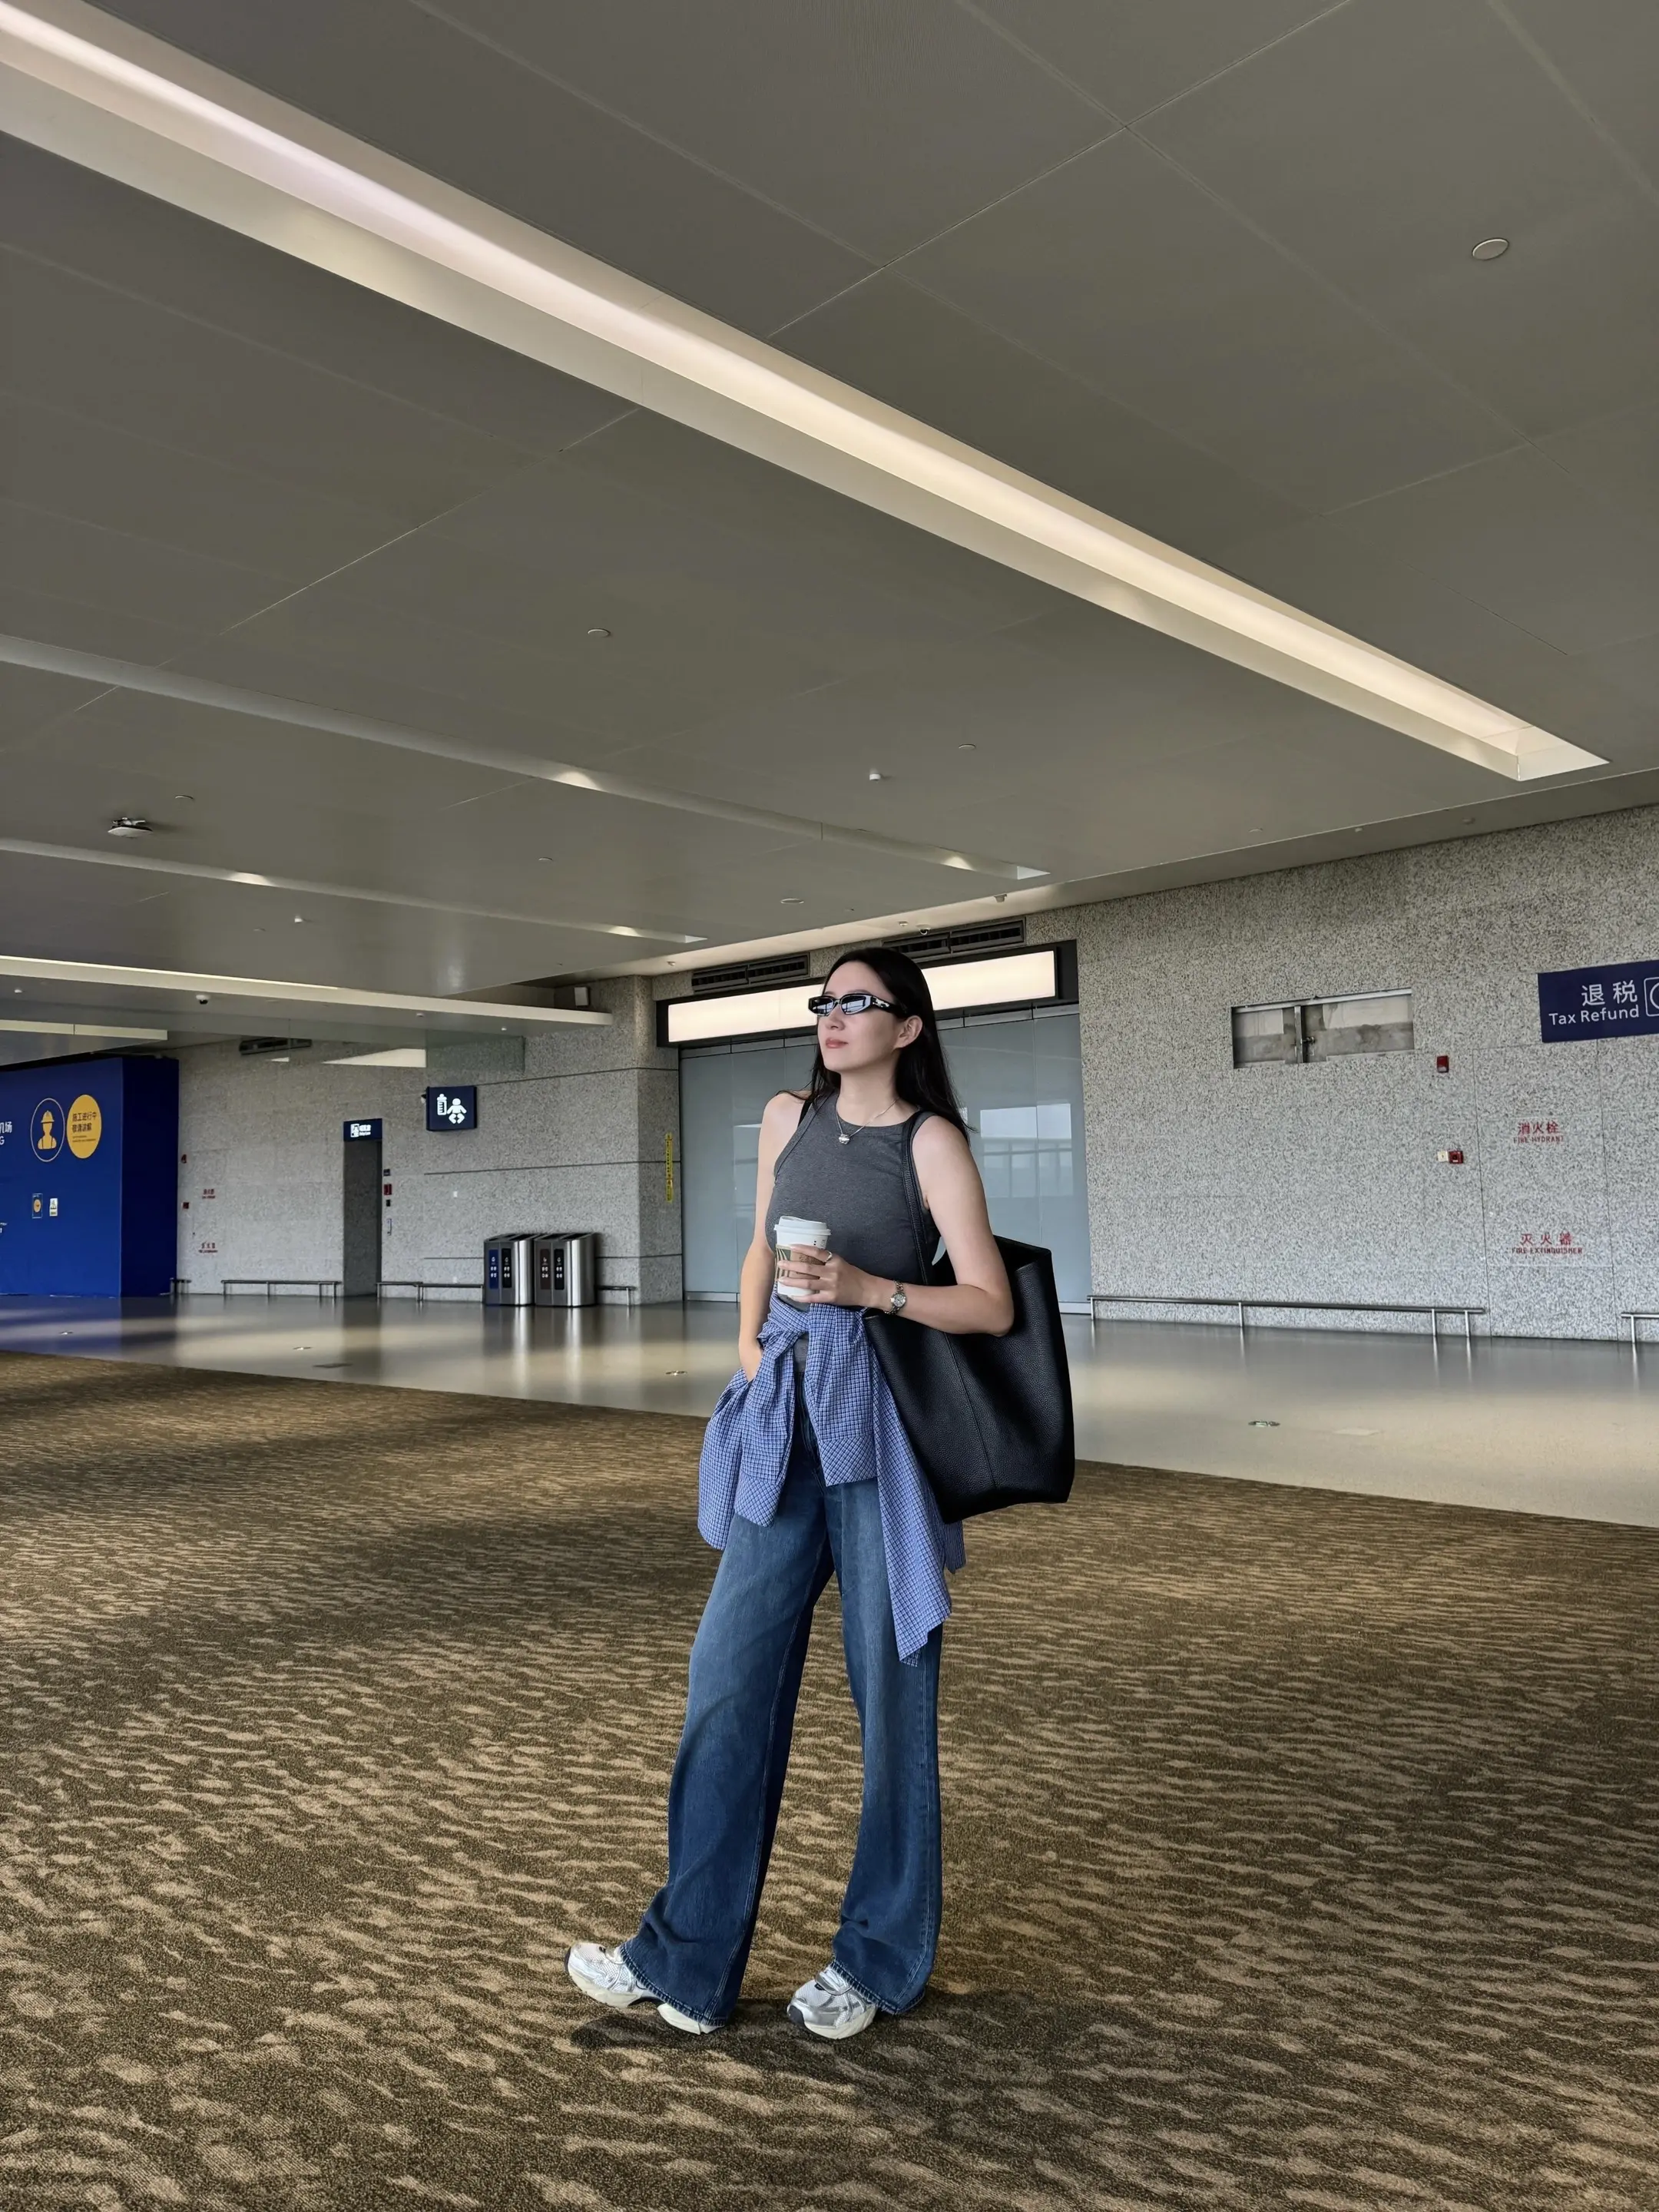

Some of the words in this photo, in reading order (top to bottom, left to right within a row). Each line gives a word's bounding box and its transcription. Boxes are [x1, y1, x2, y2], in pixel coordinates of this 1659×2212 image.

[1581, 980, 1637, 1006] 退税
[1548, 1013, 1576, 1025] Tax
[1581, 1005, 1639, 1022] Refund
[1518, 1121, 1558, 1134] 消火栓
[1520, 1231, 1571, 1245] 灭火器
